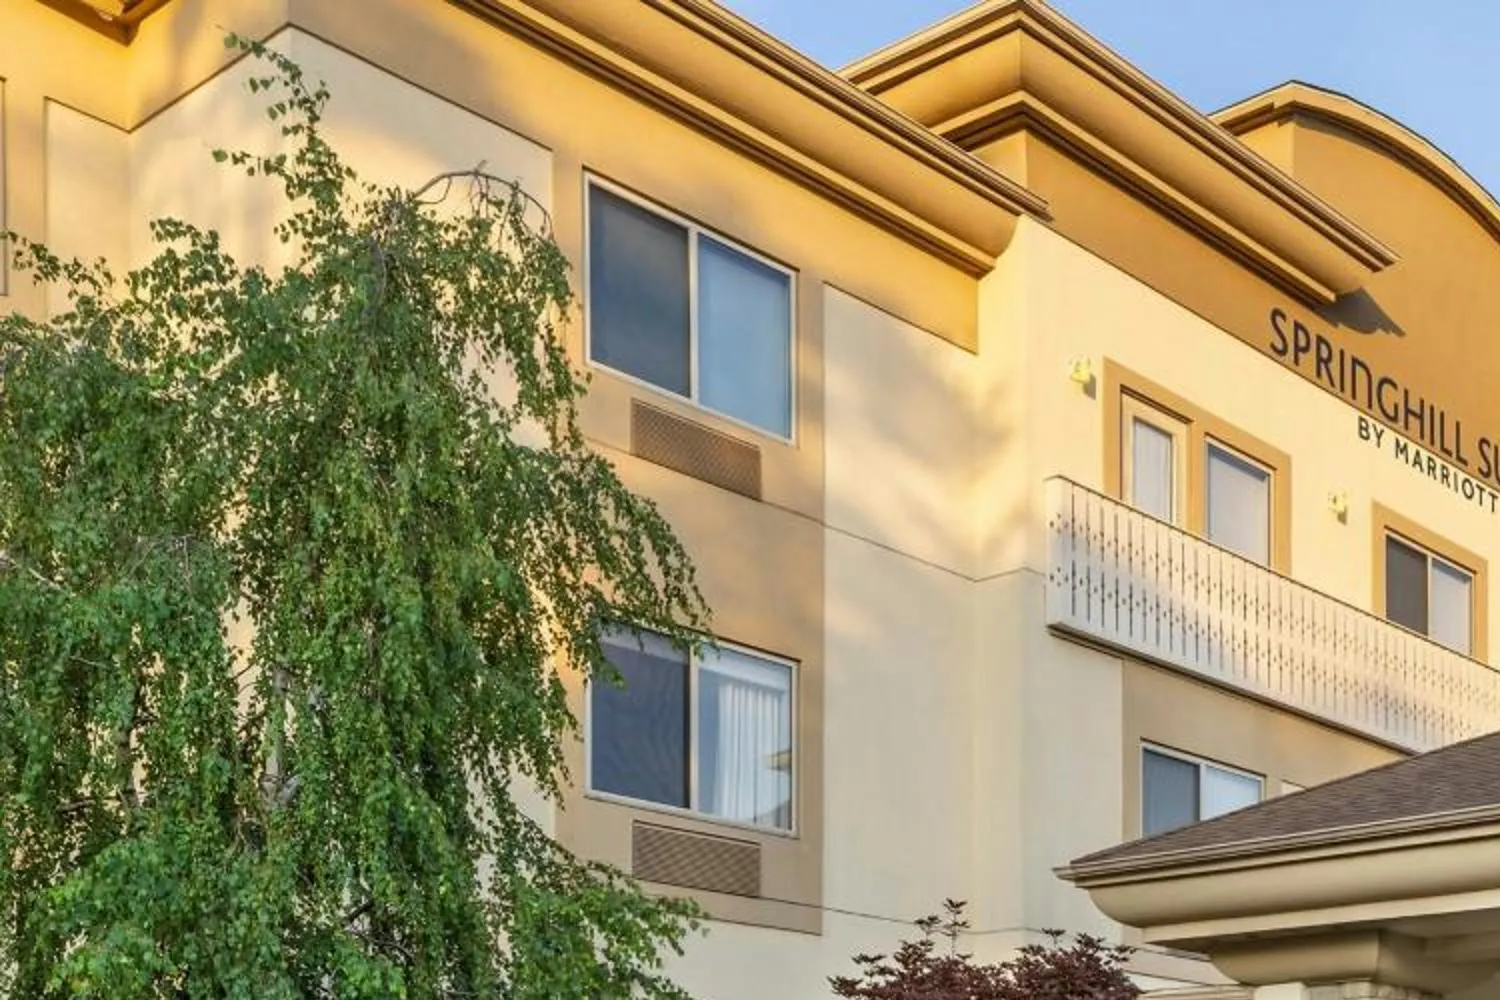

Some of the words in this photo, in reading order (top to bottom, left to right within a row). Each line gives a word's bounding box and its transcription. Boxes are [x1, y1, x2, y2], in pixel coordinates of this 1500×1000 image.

[1270, 307, 1468, 467] SPRINGHILL
[1358, 415, 1385, 449] BY
[1395, 438, 1499, 513] MARRIOTT
